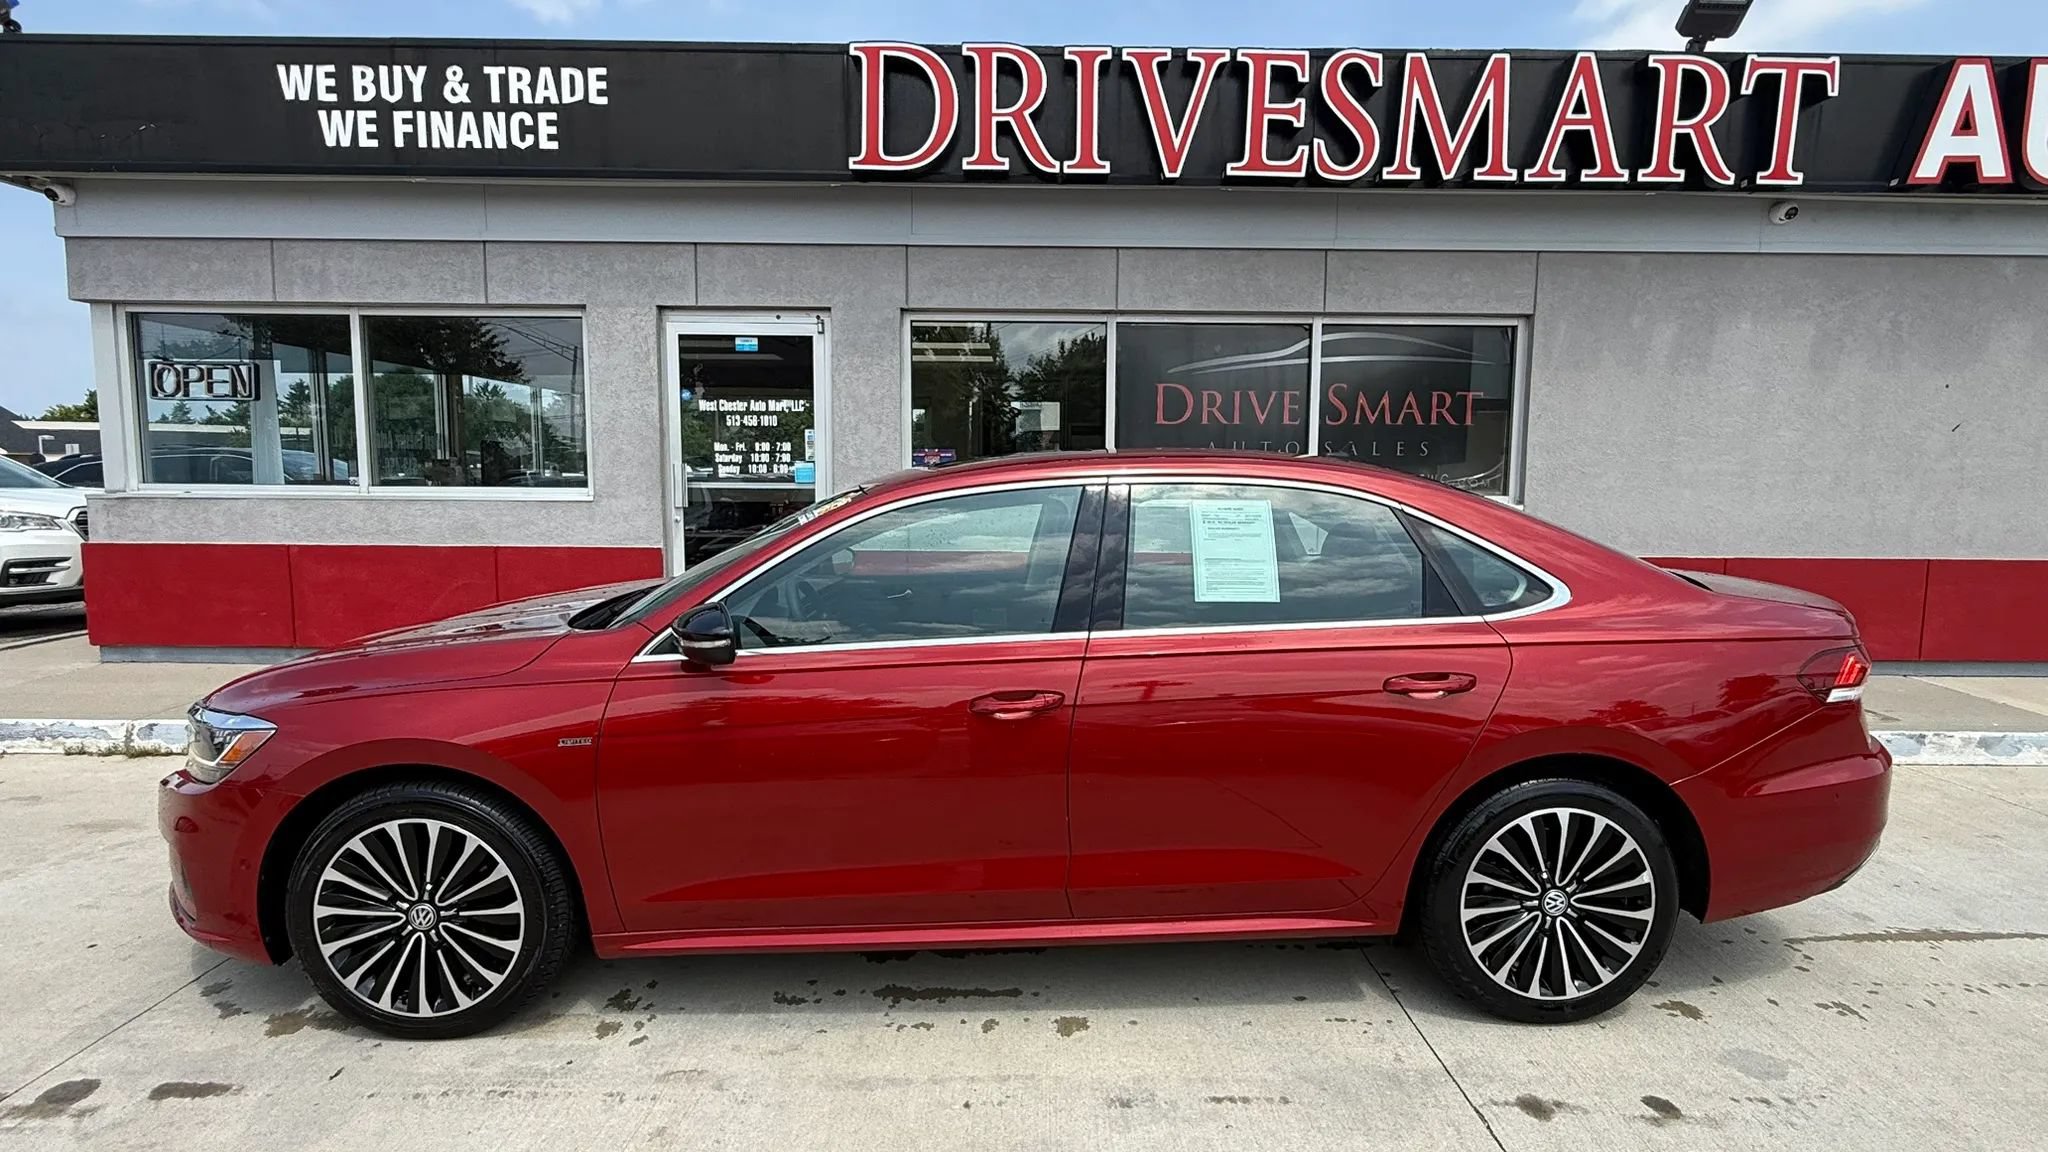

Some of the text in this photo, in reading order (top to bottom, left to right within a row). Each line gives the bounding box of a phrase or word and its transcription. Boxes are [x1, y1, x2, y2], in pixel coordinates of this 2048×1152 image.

[276, 64, 608, 104] WE BUY & TRADE
[317, 110, 559, 150] WE FINANCE
[848, 41, 1840, 186] DRIVESMART
[153, 364, 251, 398] OPEN
[698, 399, 718, 411] West
[719, 399, 748, 412] Chester
[750, 399, 766, 412] Auto
[1155, 383, 1484, 426] DRIVE SMART
[715, 453, 743, 463] Saturday
[1324, 441, 1429, 457] SALES
[718, 464, 740, 475] Sunday
